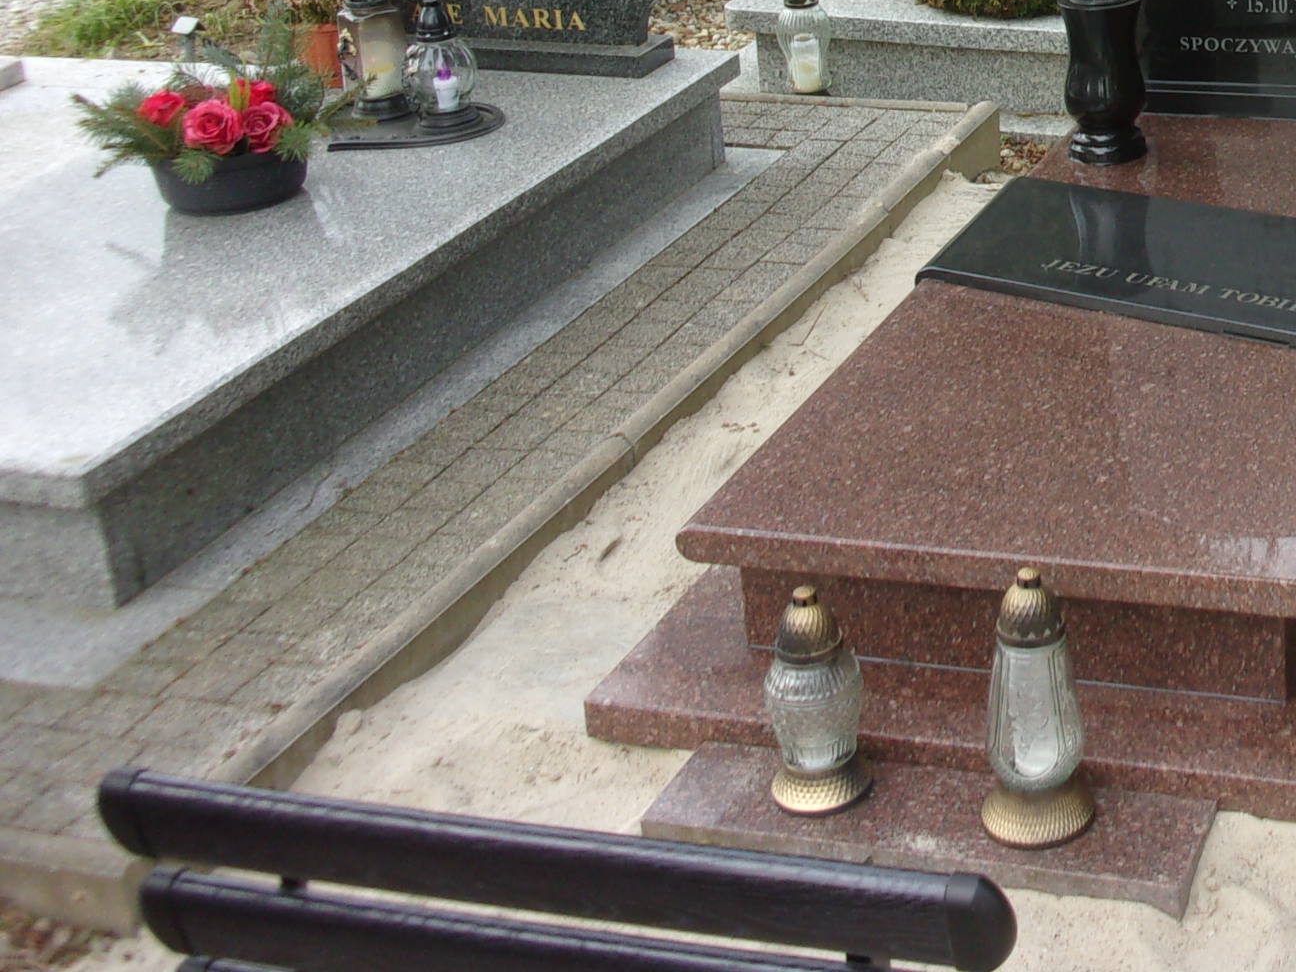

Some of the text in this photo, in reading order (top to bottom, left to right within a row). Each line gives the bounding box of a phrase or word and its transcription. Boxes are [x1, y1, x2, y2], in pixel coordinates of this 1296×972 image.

[412, 2, 587, 31] AE MARIA
[1040, 259, 1120, 278] JEZU
[1125, 273, 1212, 295] UFAM
